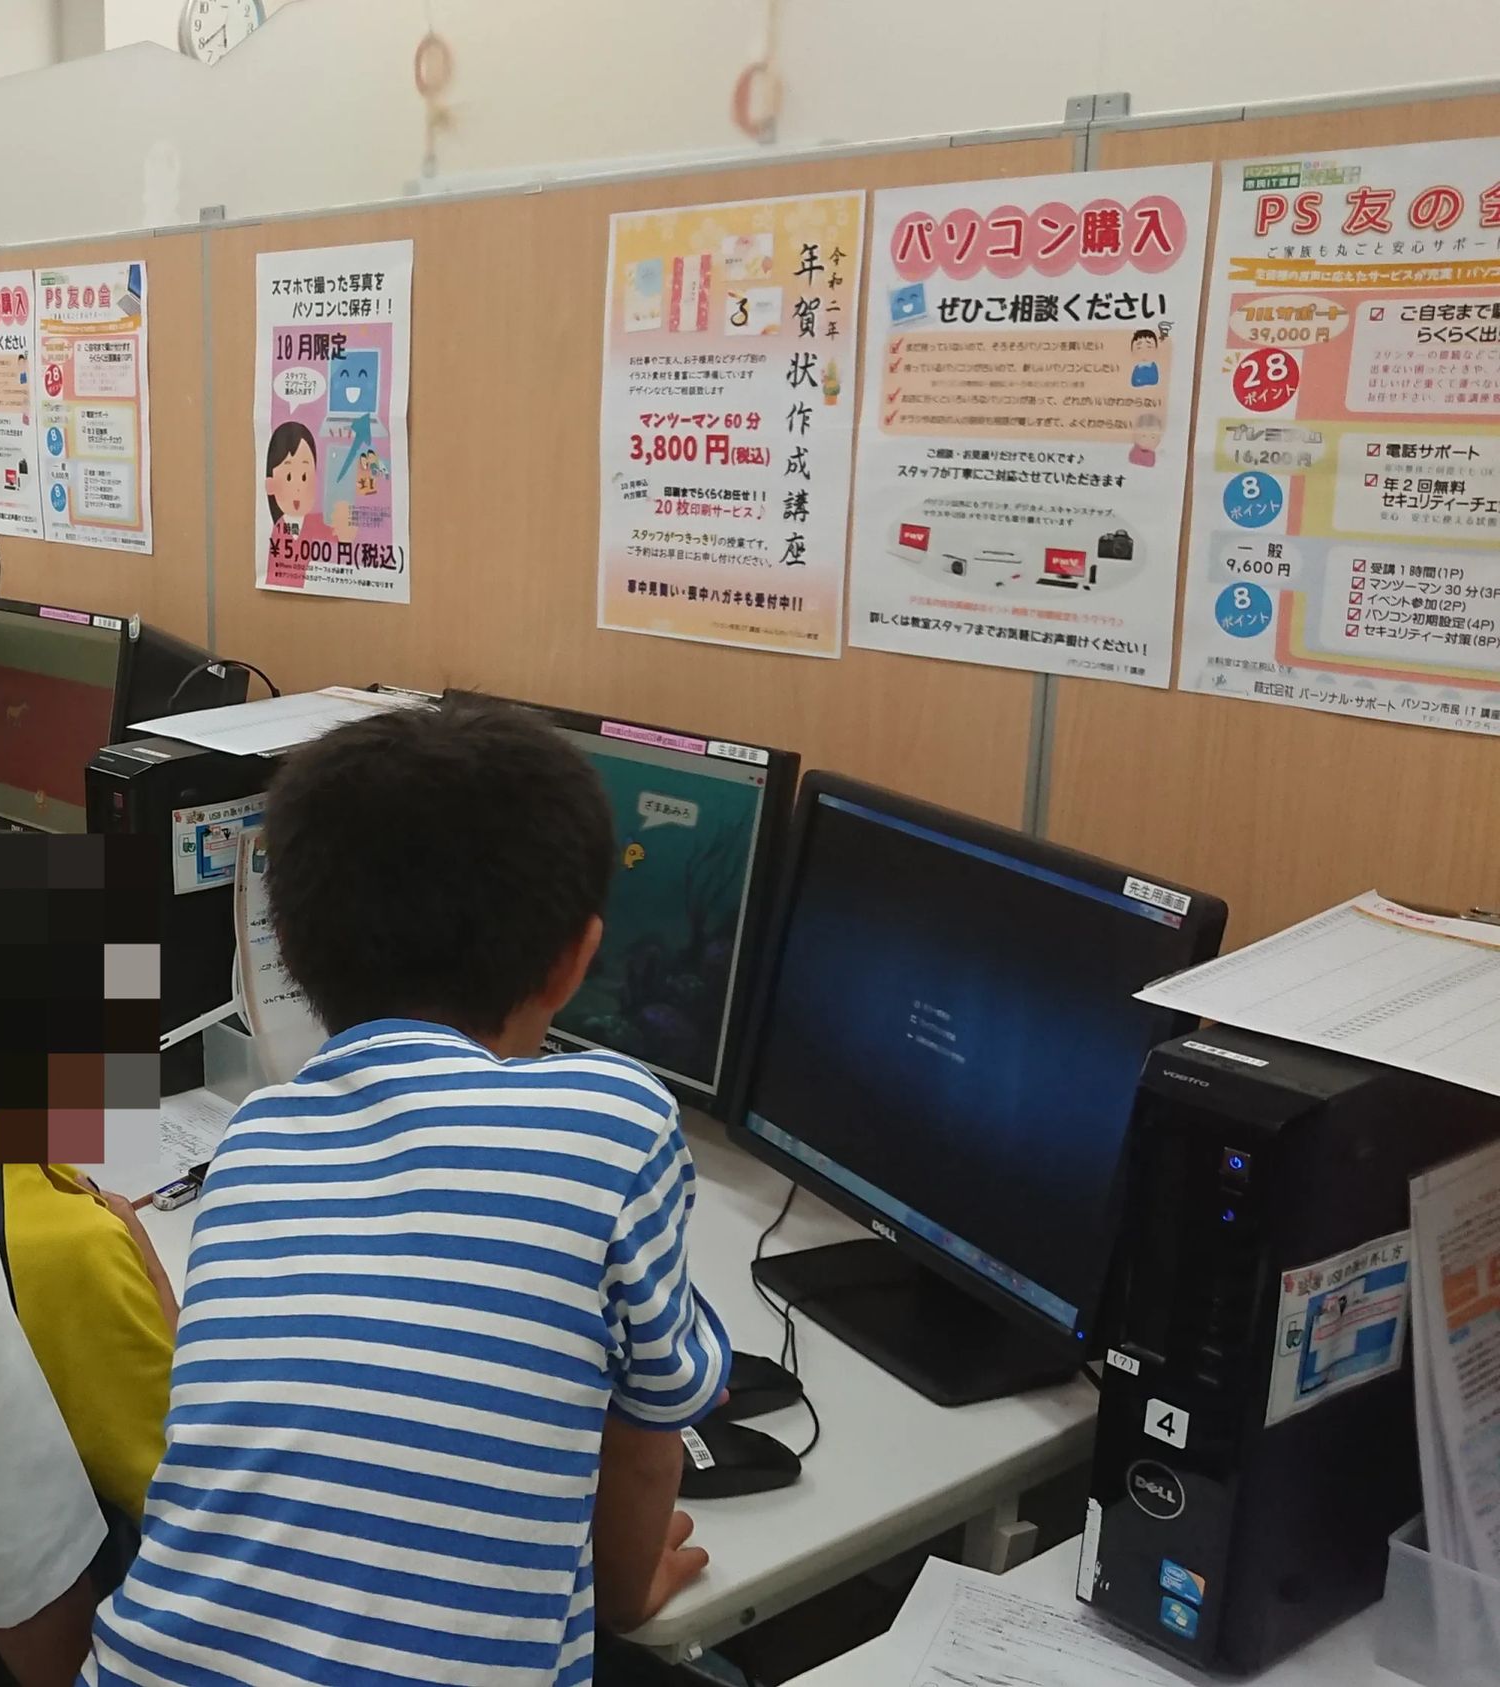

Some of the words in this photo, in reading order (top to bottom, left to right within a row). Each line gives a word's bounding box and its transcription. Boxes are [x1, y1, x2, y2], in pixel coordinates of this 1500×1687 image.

[896, 207, 1174, 263] パソコン購入
[1266, 237, 1500, 259] ご家族も丸ごと安心サポー
[271, 272, 385, 296] スマホで撮った写真を
[824, 246, 847, 341] 令和二年
[292, 298, 393, 318] パソコンに保存！！
[936, 292, 1168, 324] ぜひご相談ください
[1248, 327, 1330, 344] 39,000円
[1417, 325, 1500, 344] らくらく出
[276, 332, 348, 361] 10月限定
[1240, 352, 1289, 389] 28
[778, 243, 826, 567] 年賀状作成講座
[1244, 386, 1297, 406] ポイント
[629, 434, 771, 466] 3,800円(税込)
[1386, 443, 1480, 461] 電話サポート
[1241, 475, 1261, 499] 8
[1230, 502, 1281, 520] ポイント
[1381, 492, 1500, 513] セキュリティーチェ
[269, 537, 405, 574] ¥5,000円(税込)
[1226, 558, 1291, 578] 9,600円
[1233, 587, 1252, 610] 8
[1367, 593, 1467, 613] イベント参加(2P)
[1220, 612, 1270, 630] ポイント
[1365, 609, 1495, 632] パソコン初期設定(4P)
[1253, 680, 1295, 698] 株式会社
[644, 798, 691, 819] ざまあみろ
[1128, 879, 1187, 912] 先生用画面
[871, 1219, 898, 1243] DELL
[1156, 1411, 1176, 1438] 4
[1133, 1473, 1178, 1505] DELL
